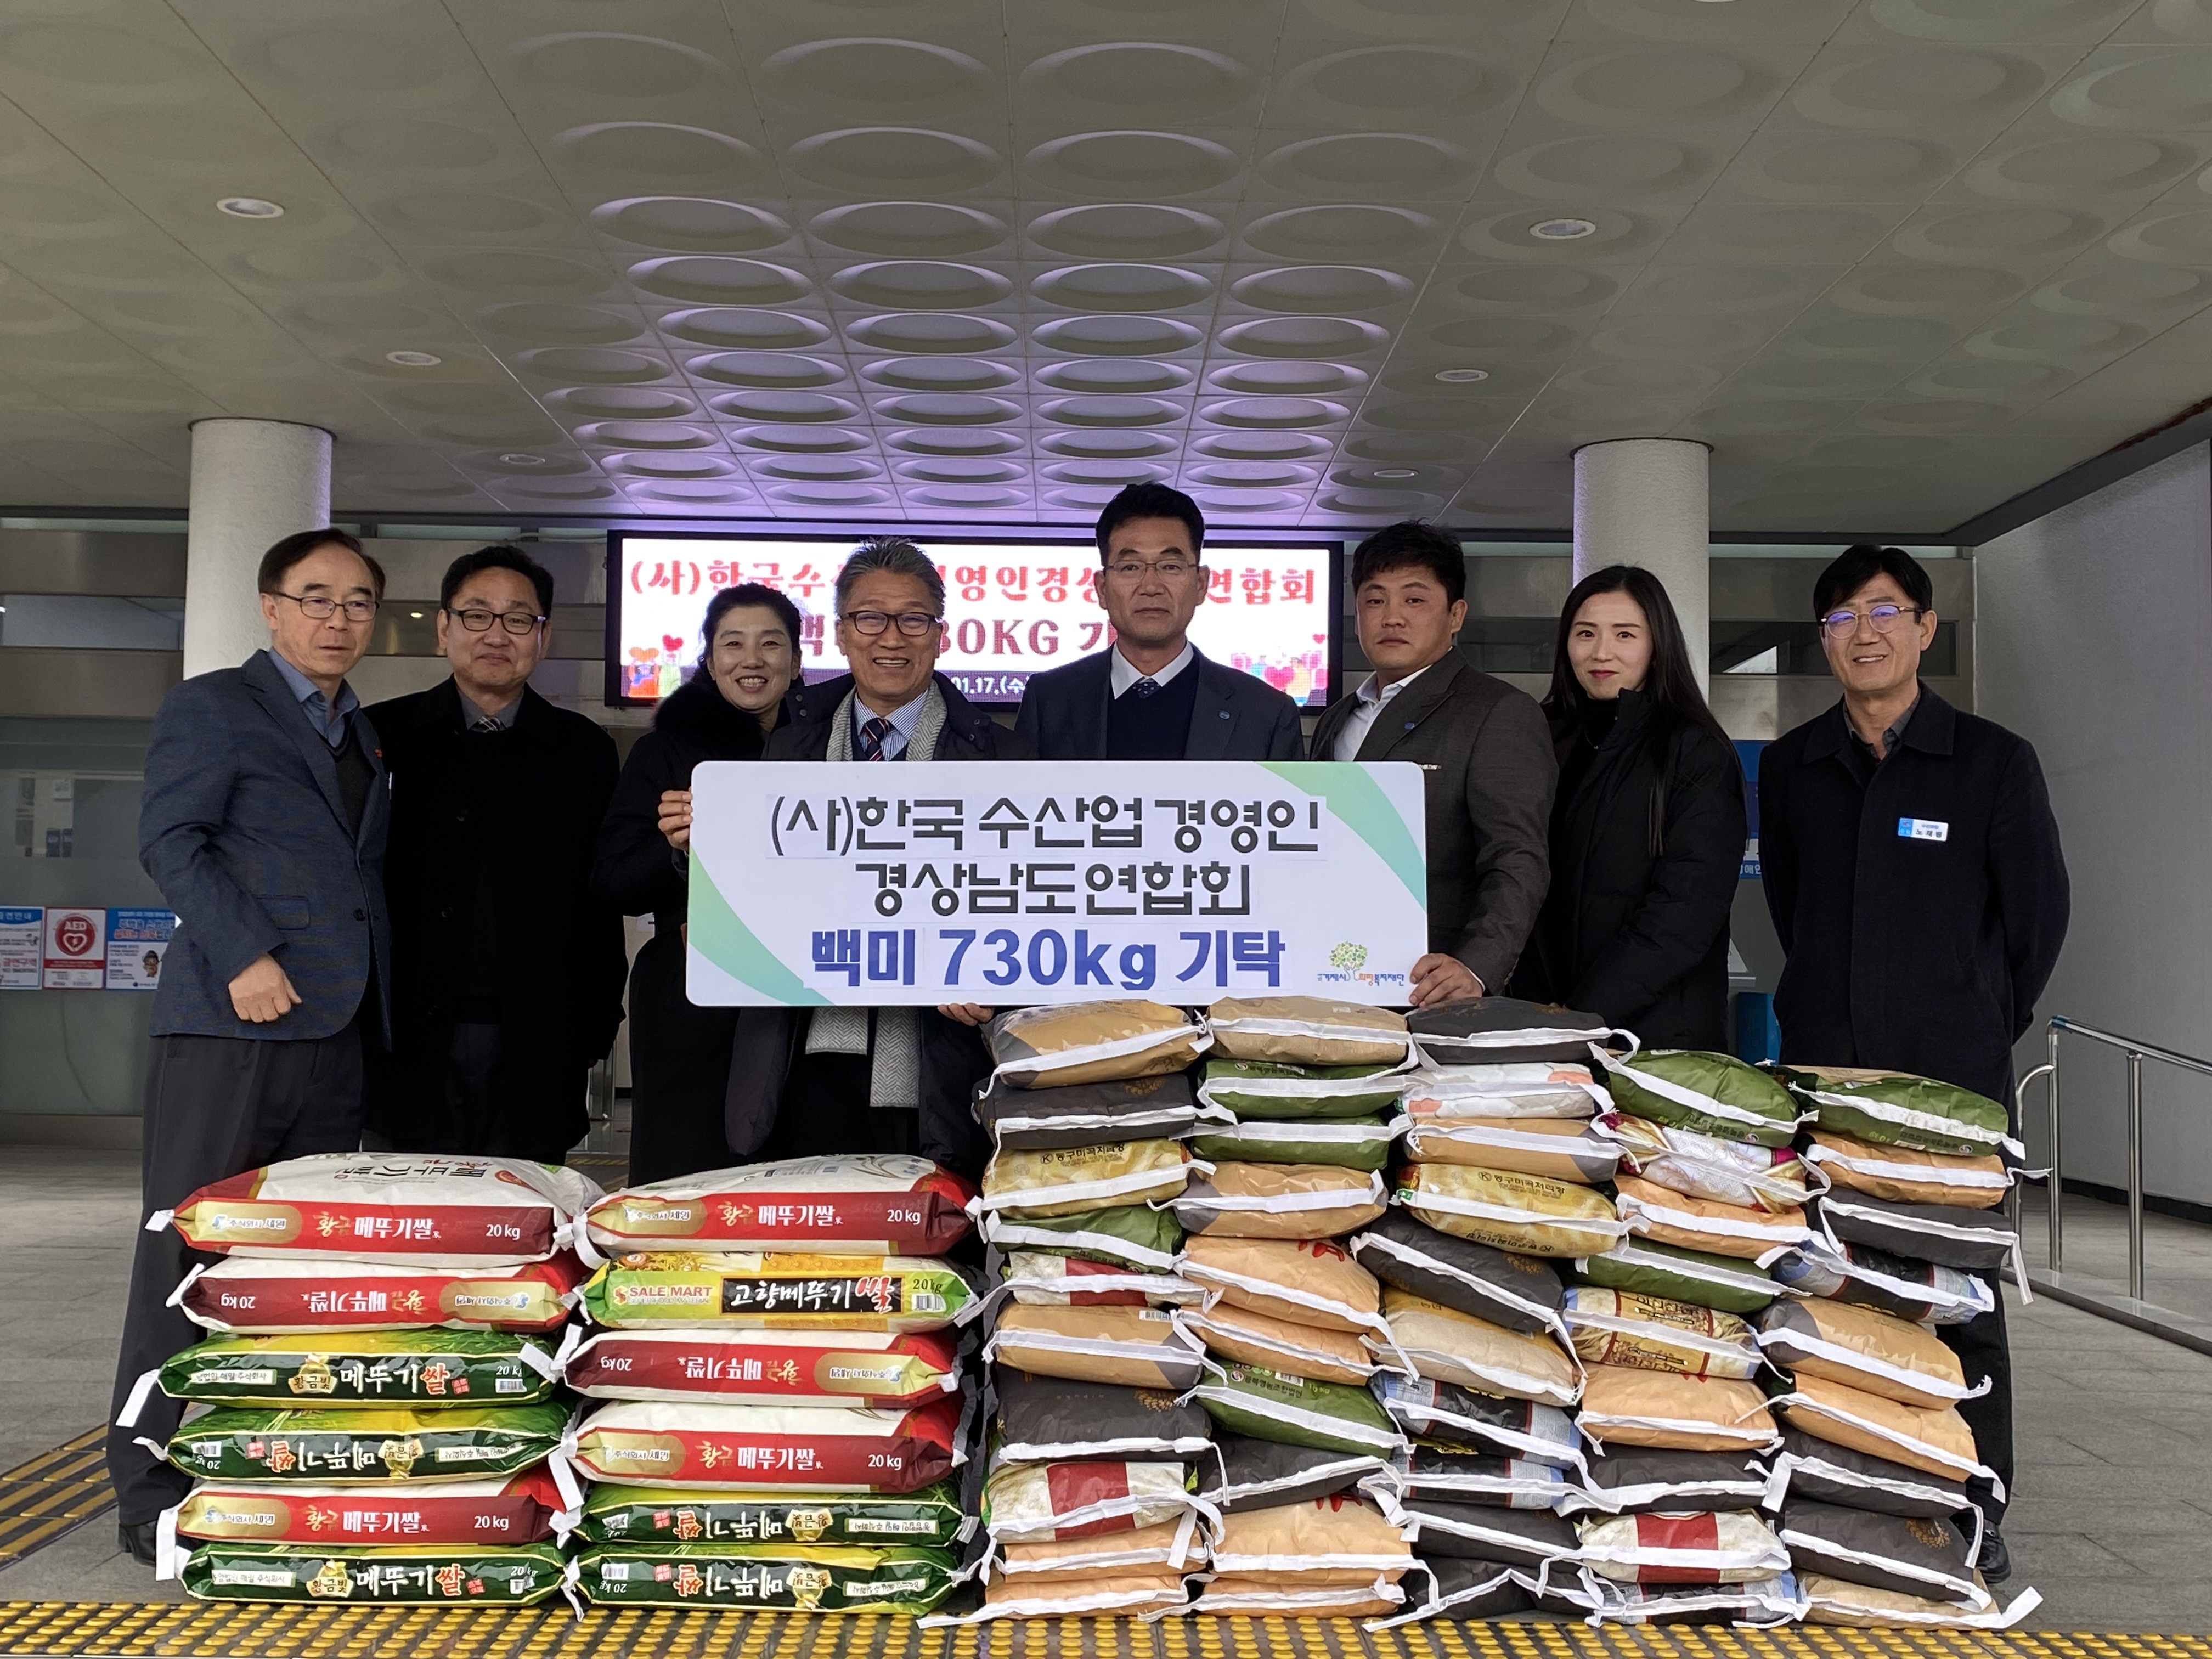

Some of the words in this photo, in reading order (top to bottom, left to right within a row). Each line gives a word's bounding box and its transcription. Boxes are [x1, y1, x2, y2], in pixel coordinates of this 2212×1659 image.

[1154, 798, 1319, 853] 경영인
[856, 861, 1250, 916] 경상남도연합회
[64, 921, 87, 931] AED
[811, 928, 916, 988] 백미
[939, 930, 1158, 990] 730kg
[1175, 929, 1286, 988] 기탁
[313, 1210, 352, 1238] 황금
[354, 1216, 435, 1240] 메뚜기쌀
[717, 1200, 755, 1227] 황금
[758, 1205, 836, 1226] 메뚜기쌀
[887, 1209, 903, 1222] 20
[906, 1209, 921, 1226] kg
[486, 1224, 502, 1238] 20
[504, 1225, 521, 1241] kg
[221, 1293, 238, 1310] kg
[239, 1295, 256, 1309] 20
[308, 1290, 387, 1313] 메뚜기쌀
[390, 1289, 428, 1316] 황금
[630, 1286, 666, 1297] SALE
[670, 1286, 713, 1297] MART
[730, 1275, 895, 1314] 고향메뚜기쌀
[496, 1365, 511, 1375] 20
[600, 1356, 615, 1371] kg
[616, 1358, 633, 1372] 20
[685, 1357, 763, 1380] 메뚜기쌀
[766, 1359, 802, 1386] 황금
[340, 1362, 450, 1395] 메뚜기쌀
[266, 1440, 376, 1473] 메뚜기쌀
[695, 1440, 733, 1469] 황금
[737, 1447, 816, 1471] 메뚜기쌀
[868, 1454, 884, 1468] 20
[886, 1454, 902, 1470] kg
[304, 1505, 338, 1532] 황금
[342, 1510, 422, 1533] 메뚜기쌀
[474, 1515, 490, 1529] 20
[493, 1515, 509, 1531] kg
[673, 1510, 783, 1539] 메뚜기쌀
[356, 1563, 465, 1597] 메뚜기쌀
[510, 1566, 524, 1576] 20
[673, 1565, 783, 1599] 메뚜기쌀
[613, 1584, 627, 1593] 20
